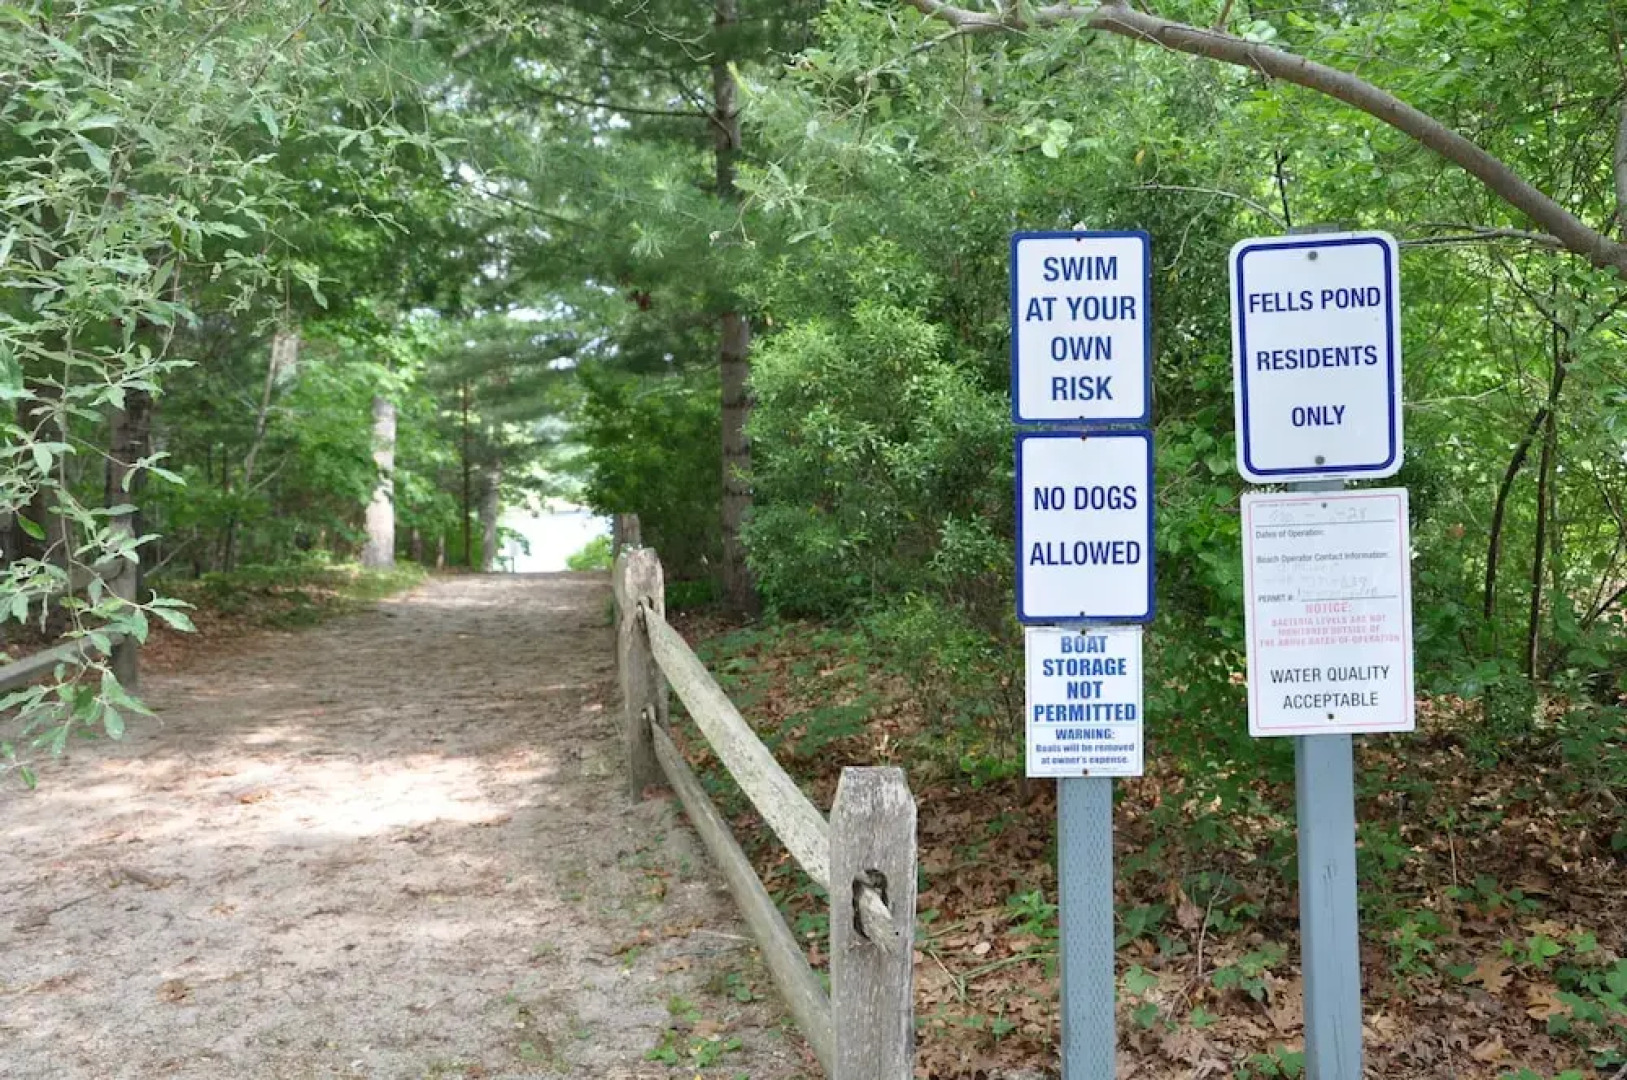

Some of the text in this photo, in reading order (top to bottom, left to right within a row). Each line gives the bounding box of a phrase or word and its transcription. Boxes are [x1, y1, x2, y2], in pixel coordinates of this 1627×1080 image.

[1043, 256, 1118, 281] SWIM
[1025, 295, 1136, 322] AT YOUR
[1249, 286, 1381, 314] FELLS POND
[1051, 336, 1112, 361] OWN
[1256, 345, 1378, 371] RESIDENTS
[1052, 376, 1113, 401] RISK
[1291, 405, 1345, 427] ONLY
[1034, 485, 1137, 511] NO DOGS
[1255, 530, 1277, 539] Dates
[1278, 530, 1287, 538] of
[1029, 541, 1141, 566] ALLOWED
[1281, 554, 1312, 564] Operator
[1314, 552, 1343, 562] Contact
[1305, 602, 1353, 613] NOTICE:
[1060, 635, 1109, 653] BOAT
[1042, 657, 1127, 676] STORAGE
[1270, 665, 1390, 683] WATER QUALITY
[1066, 681, 1104, 699] NOT
[1283, 691, 1380, 709] ACCEPTABLE
[1034, 703, 1137, 722] PERMITTED
[1055, 728, 1117, 740] WARNING:
[1063, 743, 1079, 752] will
[1082, 743, 1093, 752] be
[1095, 743, 1135, 752] removed
[1041, 756, 1050, 764] at
[1052, 756, 1087, 764] owner's
